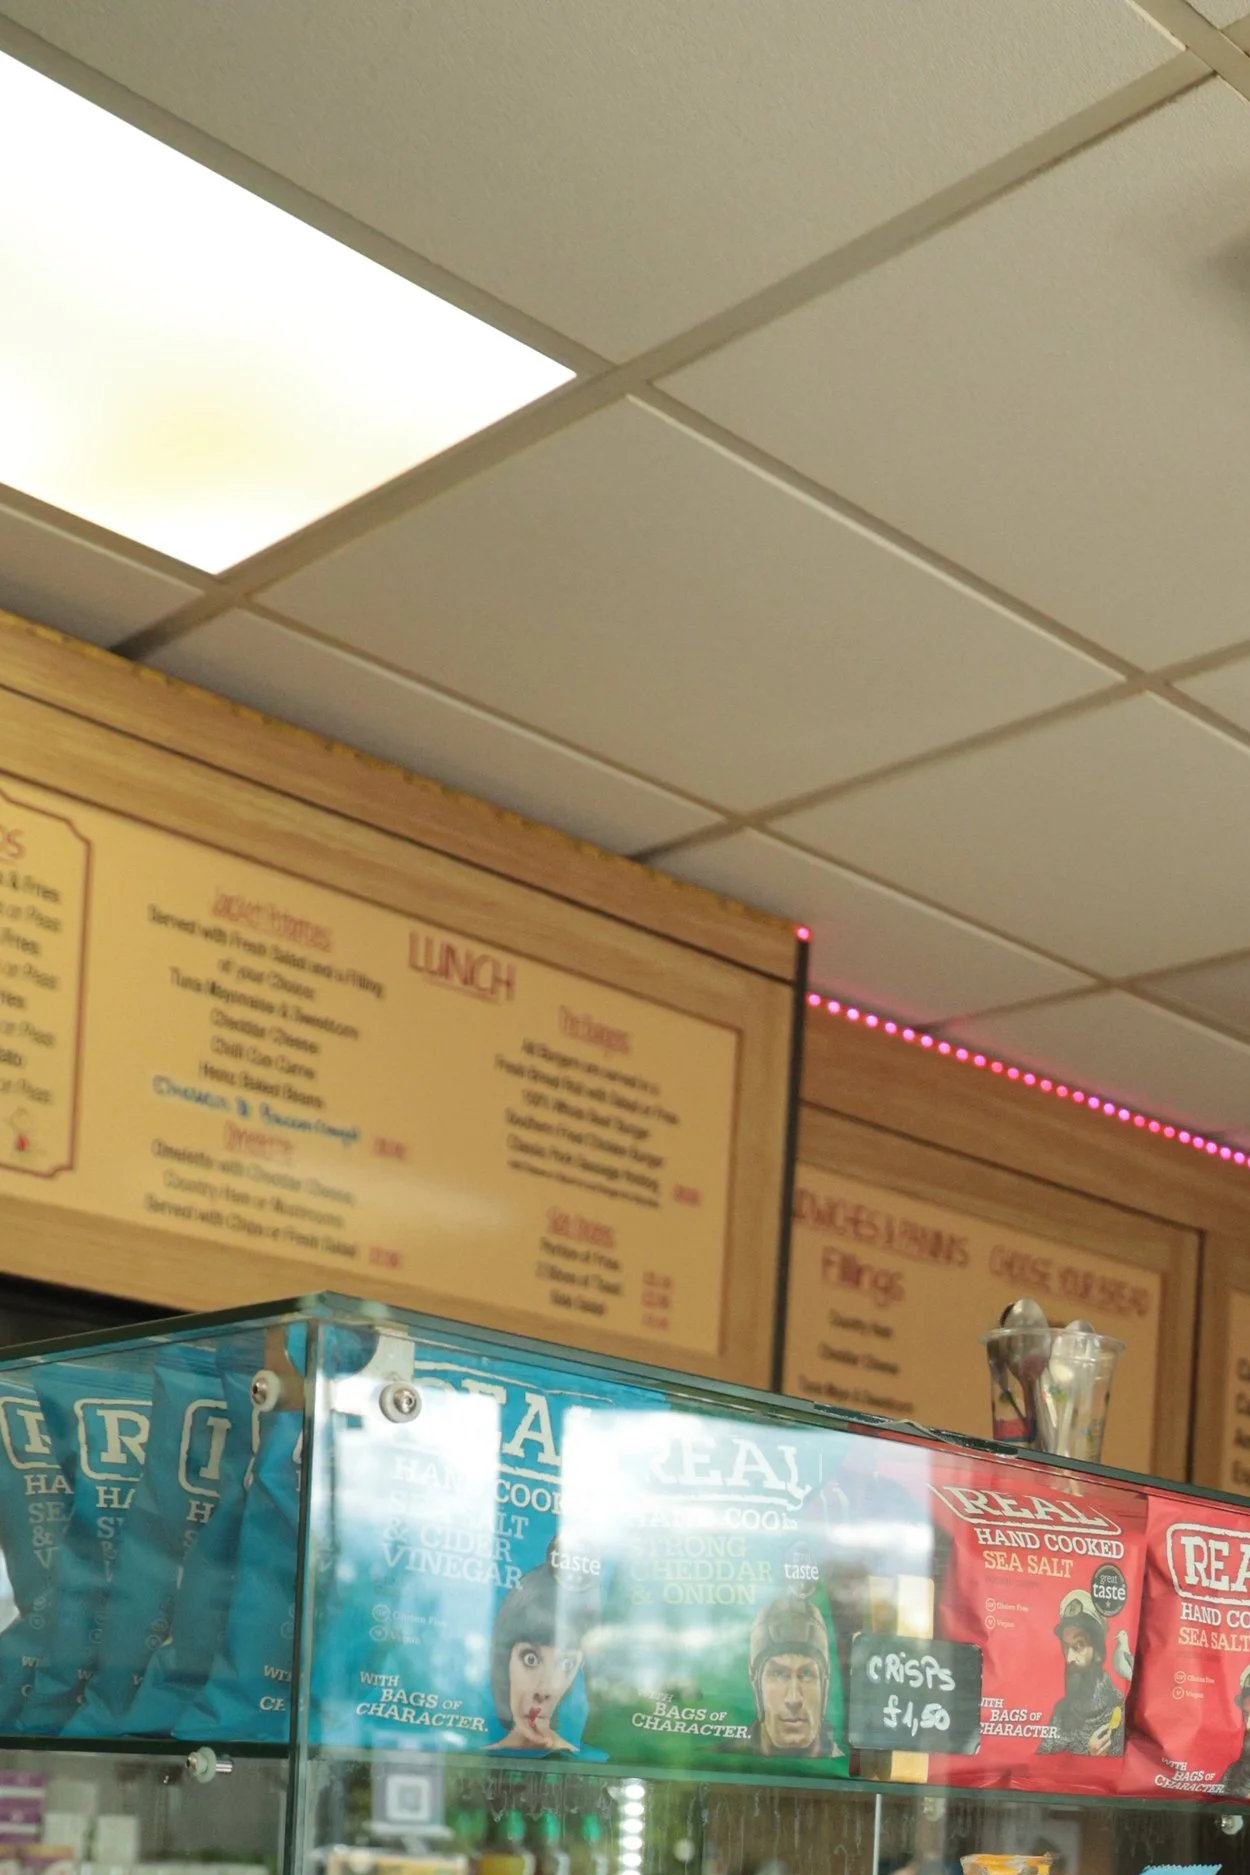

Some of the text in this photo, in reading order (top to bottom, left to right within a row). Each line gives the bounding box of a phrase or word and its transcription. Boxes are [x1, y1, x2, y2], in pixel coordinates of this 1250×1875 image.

[408, 930, 517, 1001] LUNCH
[943, 1486, 1110, 1527] REAL
[973, 1527, 1126, 1560] HAND COOKED
[381, 1542, 524, 1591] VINEGAR
[549, 1549, 601, 1577] taste
[630, 1557, 774, 1584] CHEDDAR
[783, 1563, 820, 1582] taste
[982, 1550, 1074, 1579] SEA SALT
[662, 1583, 758, 1606] ONION
[1092, 1582, 1126, 1602] taste
[1180, 1602, 1222, 1627] HAND
[1178, 1626, 1209, 1649] SEA
[360, 1671, 401, 1688] WITH
[380, 1688, 464, 1711] BAGS OF
[355, 1702, 489, 1733] CHARACTER.
[653, 1702, 729, 1722] BAGS OF
[990, 1708, 1043, 1723] BAGS OF
[631, 1712, 752, 1740] CHARACTER.
[1154, 1773, 1226, 1794] CHARACTER.
[1173, 1770, 1216, 1782] BAGS OF
